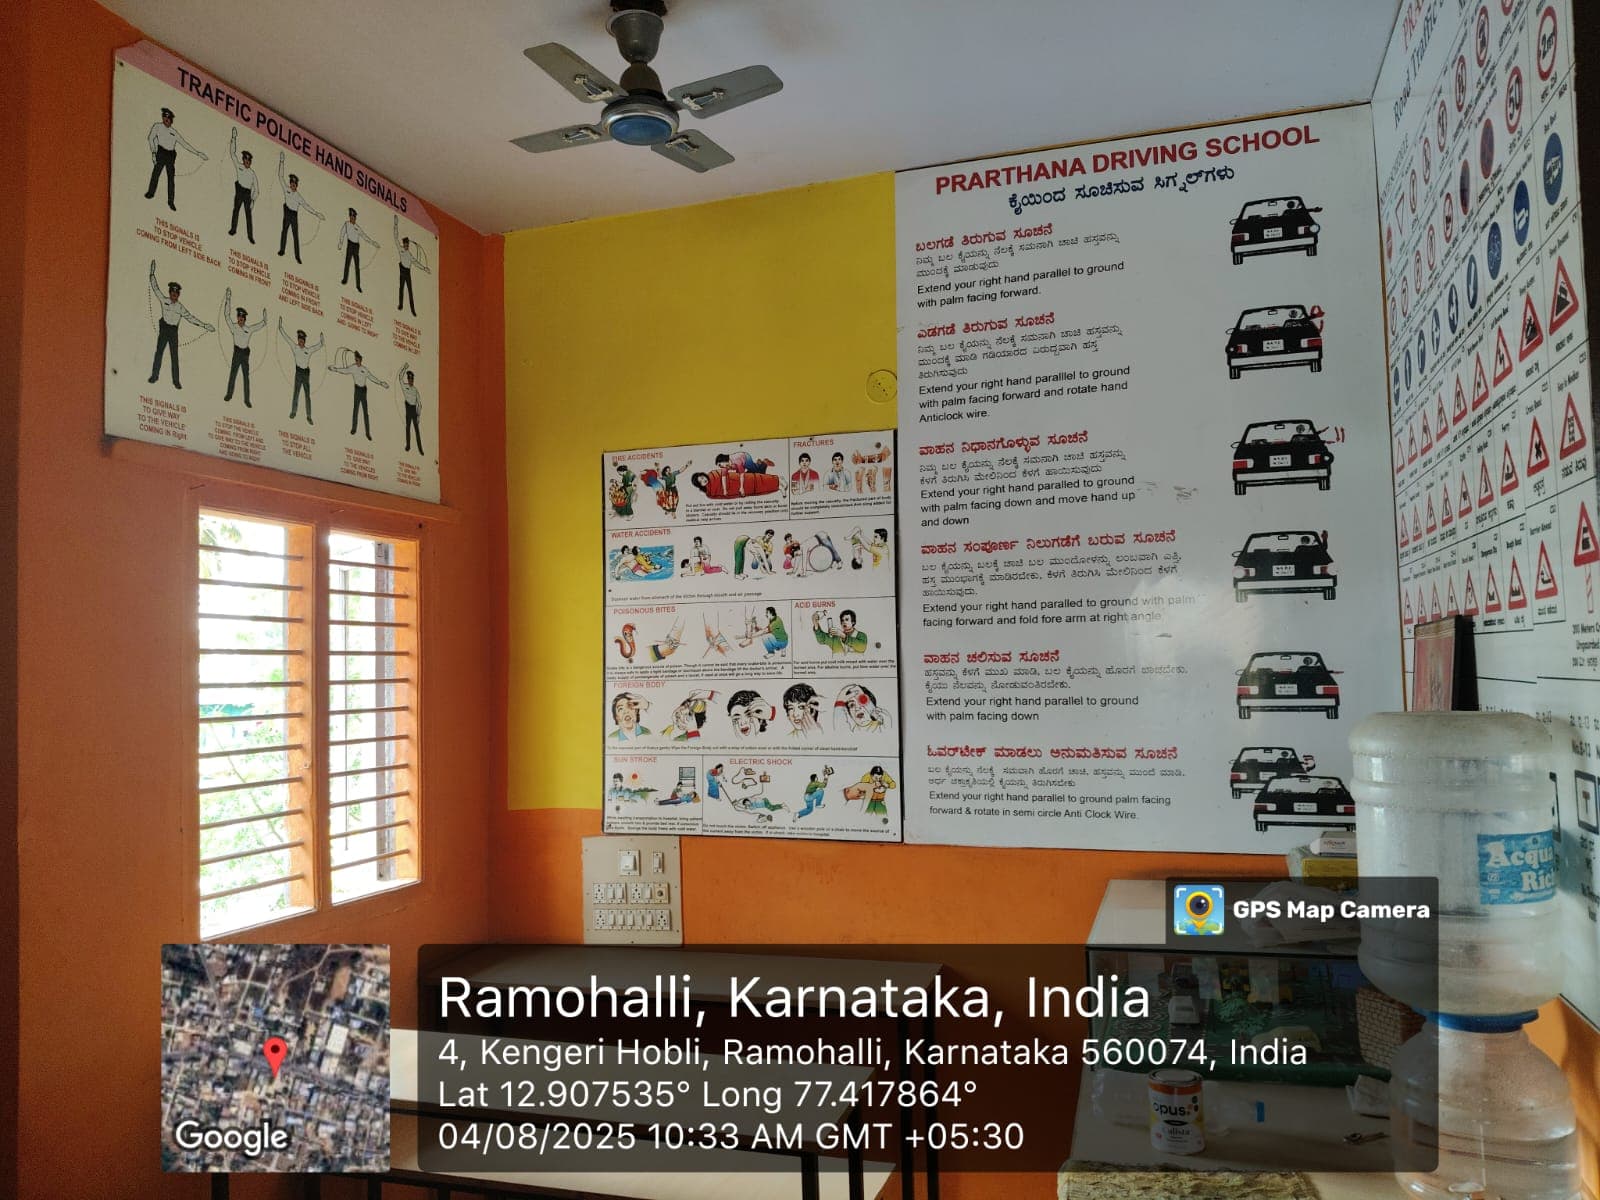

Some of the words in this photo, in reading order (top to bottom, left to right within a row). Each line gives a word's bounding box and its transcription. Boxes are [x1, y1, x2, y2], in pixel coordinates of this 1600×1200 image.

[1509, 75, 1521, 121] 50
[178, 67, 251, 123] TRAFFIC
[256, 111, 311, 156] POLICE
[316, 144, 353, 181] HAND
[356, 170, 407, 213] SIGNALS
[936, 158, 1087, 194] PRARTHANA
[1093, 142, 1198, 173] DRIVING
[1205, 125, 1320, 157] SCHOOL
[1008, 187, 1066, 215] ಕೈಯಿಂದ
[1075, 176, 1144, 199] ಸೂಚಿಸುವ
[136, 228, 160, 243] COMING
[161, 239, 177, 250] FROM
[178, 244, 192, 255] LEFT
[193, 251, 205, 262] SIDE
[206, 255, 221, 267] BACK
[916, 236, 954, 252] ಬಲಗಡೆ
[961, 230, 1006, 245] ತಿರುಗುವ
[1013, 223, 1052, 240] ಸೂಚನೆ
[918, 282, 951, 296] Extend
[955, 281, 976, 292] your
[980, 276, 1001, 290] right
[1005, 272, 1029, 284] hand
[1033, 268, 1070, 282] parallel
[1073, 265, 1085, 276] to
[1087, 261, 1124, 275] ground
[917, 297, 937, 308] with
[940, 295, 964, 307] palm
[967, 292, 997, 303] facing
[1000, 286, 1041, 299] forward.
[917, 323, 955, 338] ಎಡಗಡೆ
[963, 318, 1008, 333] ತಿರುಗುವ
[1015, 312, 1054, 328] ಸೂಚನೆ
[919, 383, 953, 395] Extend
[956, 383, 978, 393] your
[981, 379, 1003, 392] right
[1006, 375, 1032, 386] hand
[1079, 371, 1089, 379] to
[1092, 365, 1130, 381] ground
[919, 399, 939, 408] with
[942, 397, 966, 409] palm
[969, 394, 999, 404] facing
[1002, 389, 1040, 401] forward
[1044, 387, 1063, 398] and
[1067, 385, 1097, 395] rotate
[1101, 380, 1128, 392] hand
[920, 411, 963, 423] Anticlock
[794, 439, 834, 448] FRACTURES
[919, 442, 954, 455] ವಾಹನ
[961, 435, 1040, 454] ನಿಧಾನಗೊಳ್ಳುವ
[1048, 431, 1088, 445] ಸೂಚನೆ
[921, 488, 954, 498] Extend
[958, 488, 980, 498] your
[983, 485, 1005, 496] right
[1008, 482, 1034, 493] hand
[1038, 479, 1080, 493] paralled
[1083, 479, 1093, 487] to
[1097, 476, 1134, 488] ground
[921, 504, 940, 512] with
[944, 502, 967, 513] palm
[971, 500, 1001, 510] facing
[1004, 498, 1032, 507] down
[1035, 495, 1055, 505] and
[1058, 496, 1088, 504] move
[1091, 491, 1118, 503] hand
[1122, 492, 1135, 501] up
[611, 529, 633, 538] WATER
[635, 527, 671, 537] ACCIDENTS
[921, 517, 939, 527] and
[943, 517, 969, 525] down
[921, 542, 956, 554] ವಾಹನ
[963, 540, 1019, 553] ಸಂಪೂರ್ಣ
[1026, 534, 1080, 550] ನಿಲುಗಡೆಗೆ
[1088, 533, 1125, 546] ಬರುವ
[1133, 530, 1175, 543] ಸೂಚನೆ
[613, 607, 654, 615] POISONOUS
[655, 606, 676, 614] BITES
[794, 600, 810, 608] ACID
[812, 600, 836, 610] BURNS
[924, 652, 960, 664] ವಾಹನ
[967, 651, 1012, 664] ಚಲಿಸುವ
[1019, 650, 1059, 662] ಸೂಚನೆ
[926, 697, 960, 707] Extend
[963, 696, 987, 709] your
[990, 696, 1012, 708] right
[1015, 696, 1041, 710] hand
[1044, 696, 1083, 708] parallel
[1086, 696, 1097, 706] to
[1100, 696, 1138, 709] ground
[927, 711, 946, 720] with
[950, 711, 974, 722] palm
[977, 711, 1008, 723] facing
[1011, 710, 1039, 720] down
[994, 746, 1042, 758] ಮಾಡಲು
[1050, 747, 1127, 759] ಅನುಮತಿಸುವ
[1135, 747, 1177, 760] ಸೂಚನೆ
[1520, 867, 1554, 891] Ric
